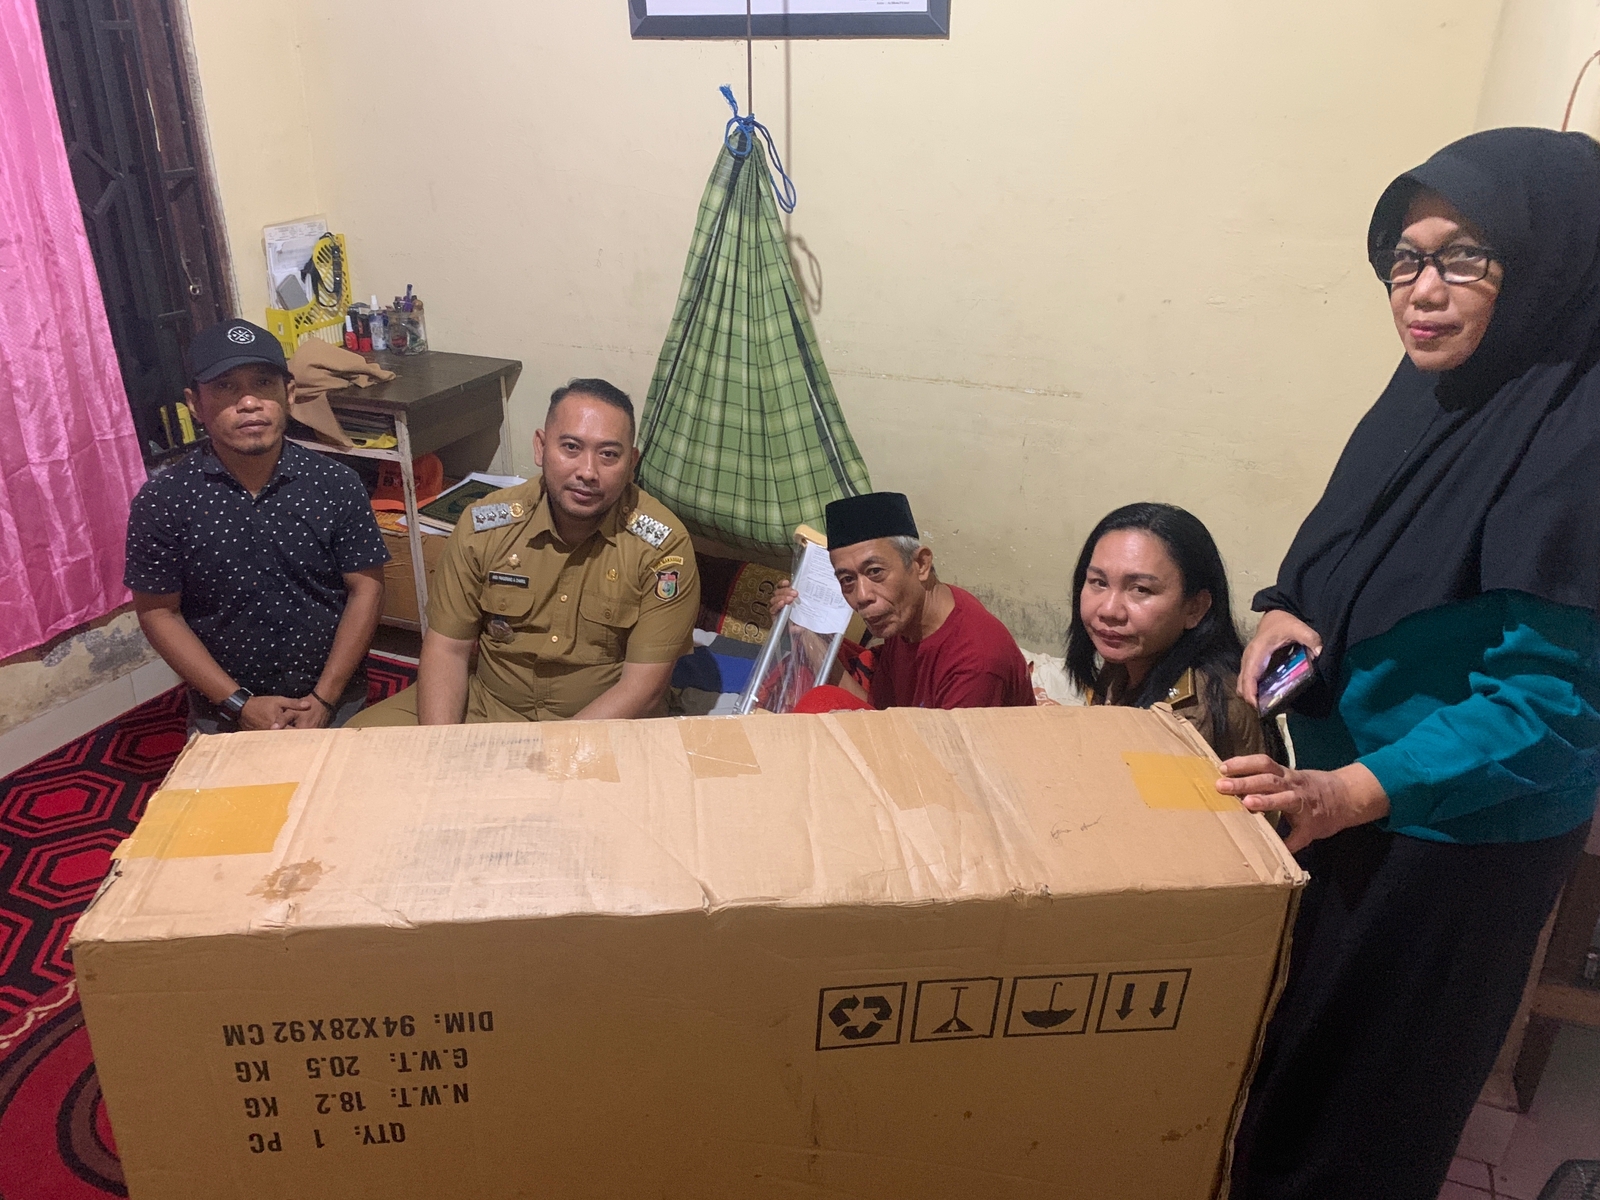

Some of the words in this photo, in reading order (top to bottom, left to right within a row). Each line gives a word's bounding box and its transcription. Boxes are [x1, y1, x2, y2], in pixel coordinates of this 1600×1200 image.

[433, 1011, 494, 1034] DIM:
[306, 1055, 361, 1080] 20.5
[390, 1047, 469, 1073] G.W.T:
[234, 1061, 271, 1083] KG
[314, 1091, 367, 1115] 18.2
[390, 1082, 469, 1108] N.W.T:
[243, 1096, 279, 1119] KG
[248, 1131, 283, 1154] PC
[313, 1129, 326, 1149] 1
[354, 1121, 406, 1146] QTY:
